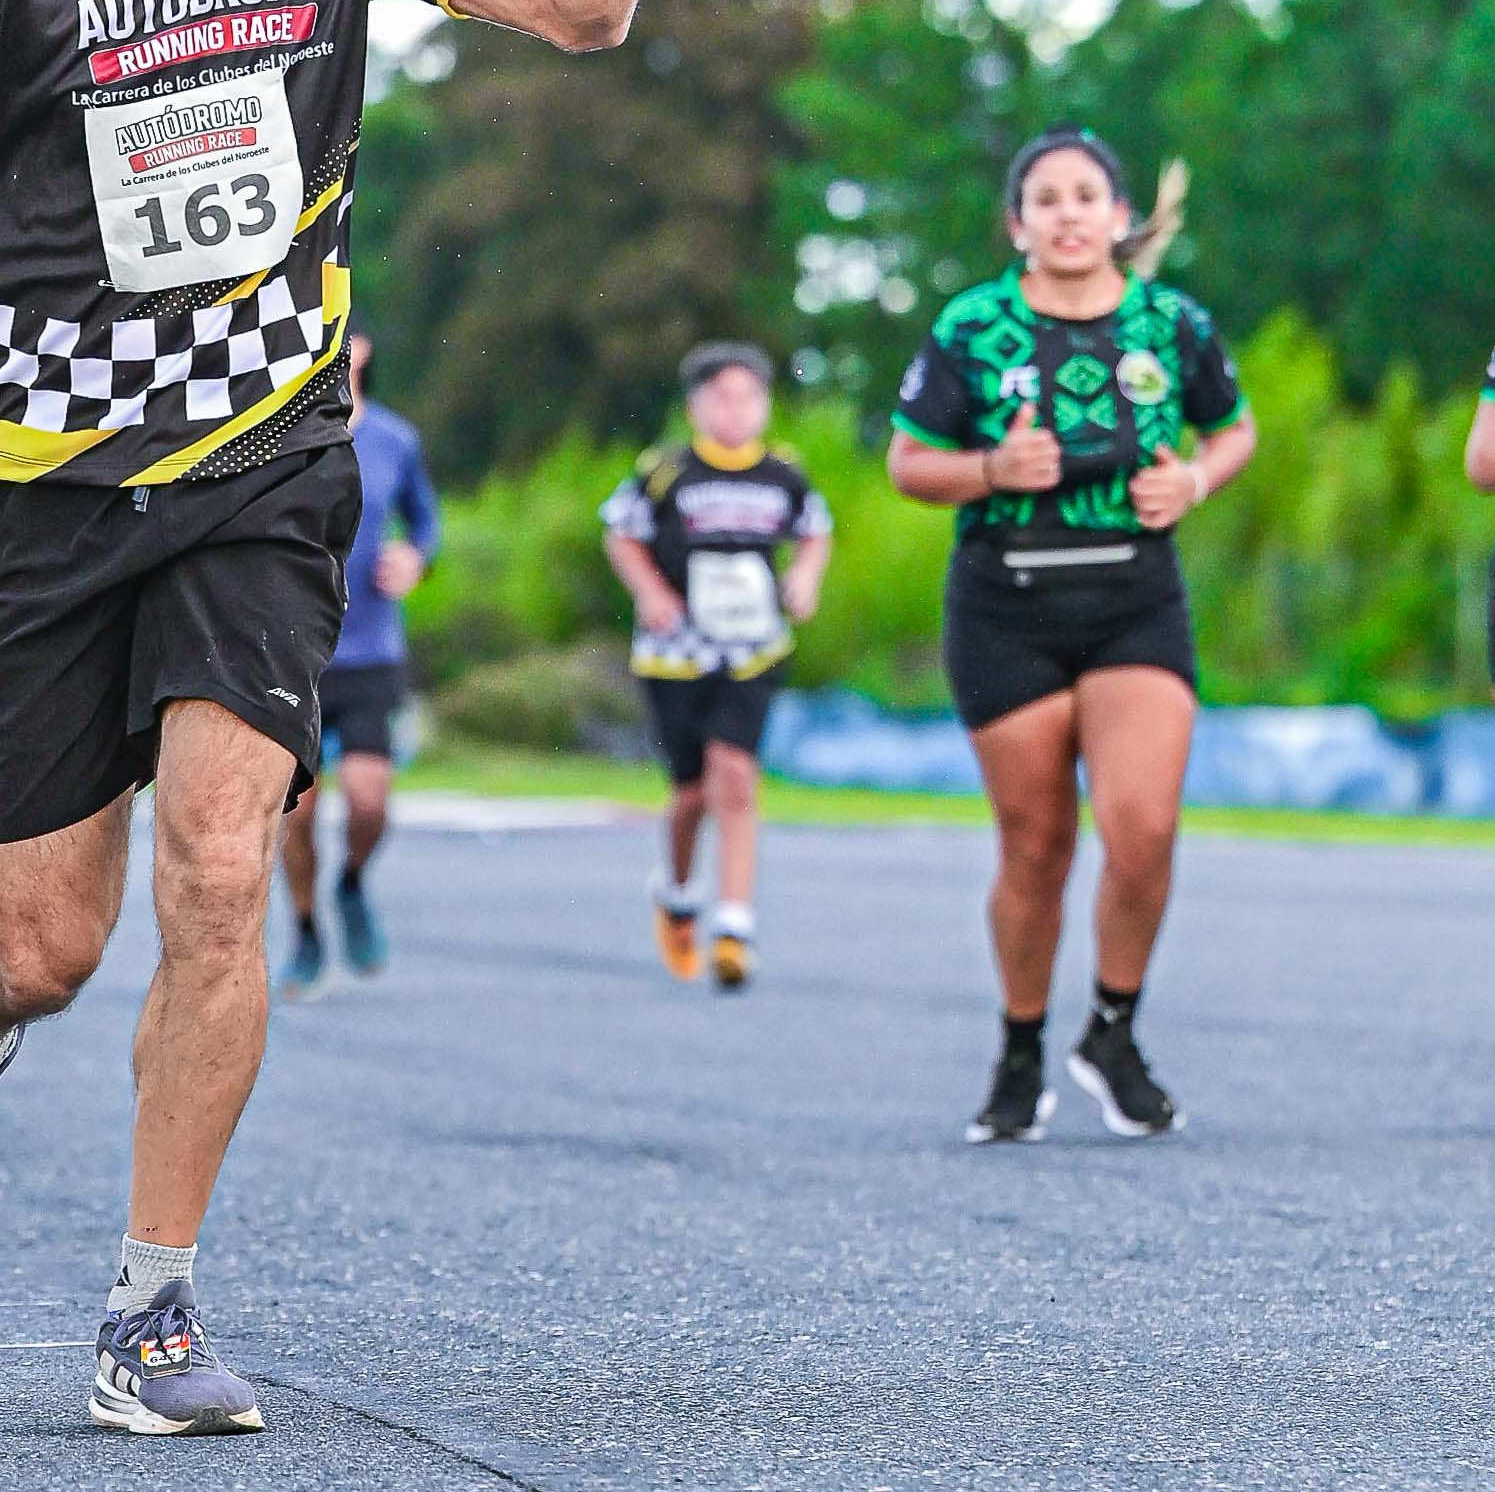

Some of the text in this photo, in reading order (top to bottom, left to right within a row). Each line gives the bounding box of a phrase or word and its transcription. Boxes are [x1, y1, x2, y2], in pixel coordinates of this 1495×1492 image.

[116, 12, 294, 76] RUNNING RACE
[71, 91, 92, 107] La
[92, 85, 150, 105] Carrera
[153, 78, 173, 95] de
[176, 75, 196, 91] los
[198, 66, 251, 86] Clubes
[254, 54, 276, 73] del
[115, 96, 263, 155] AUTÓDROMO
[143, 131, 244, 169] RUNNING RACE
[120, 145, 270, 187] La Carrera de los Clubes del Noroeste
[134, 173, 276, 258] 163
